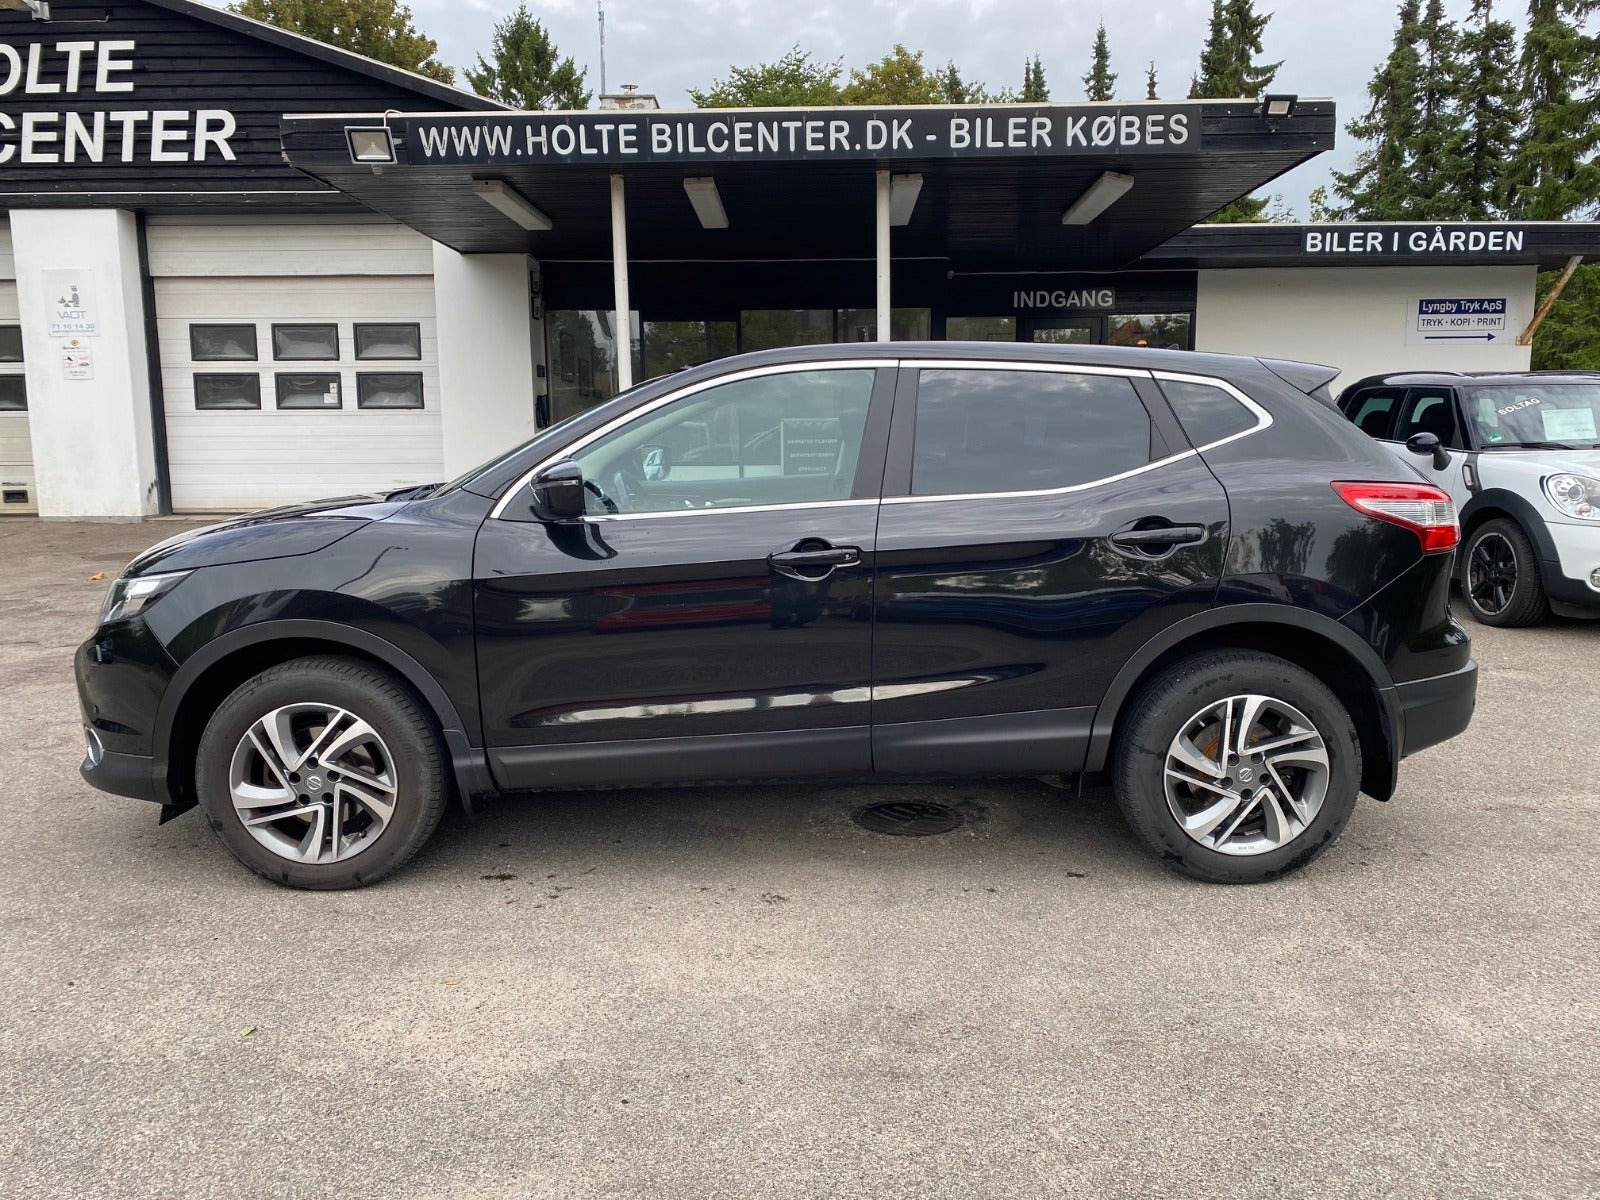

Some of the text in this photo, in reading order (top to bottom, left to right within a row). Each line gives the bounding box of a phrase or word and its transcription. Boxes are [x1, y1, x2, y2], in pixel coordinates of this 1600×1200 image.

[418, 123, 638, 157] WWW.HOLTE
[651, 118, 914, 154] BILCENTER.DK
[950, 117, 1052, 149] BILER
[1066, 113, 1189, 147] KØBES
[1306, 226, 1524, 252] BILER I GÅRDEN
[1013, 289, 1113, 308] INDGANG
[1422, 301, 1503, 313] Lyngby Tryk ApS
[57, 311, 87, 319] VAGT
[1421, 318, 1443, 327] TRYK
[1450, 318, 1471, 326] KOPI
[1477, 317, 1502, 326] PRINT
[1497, 397, 1540, 416] SOLTAG
